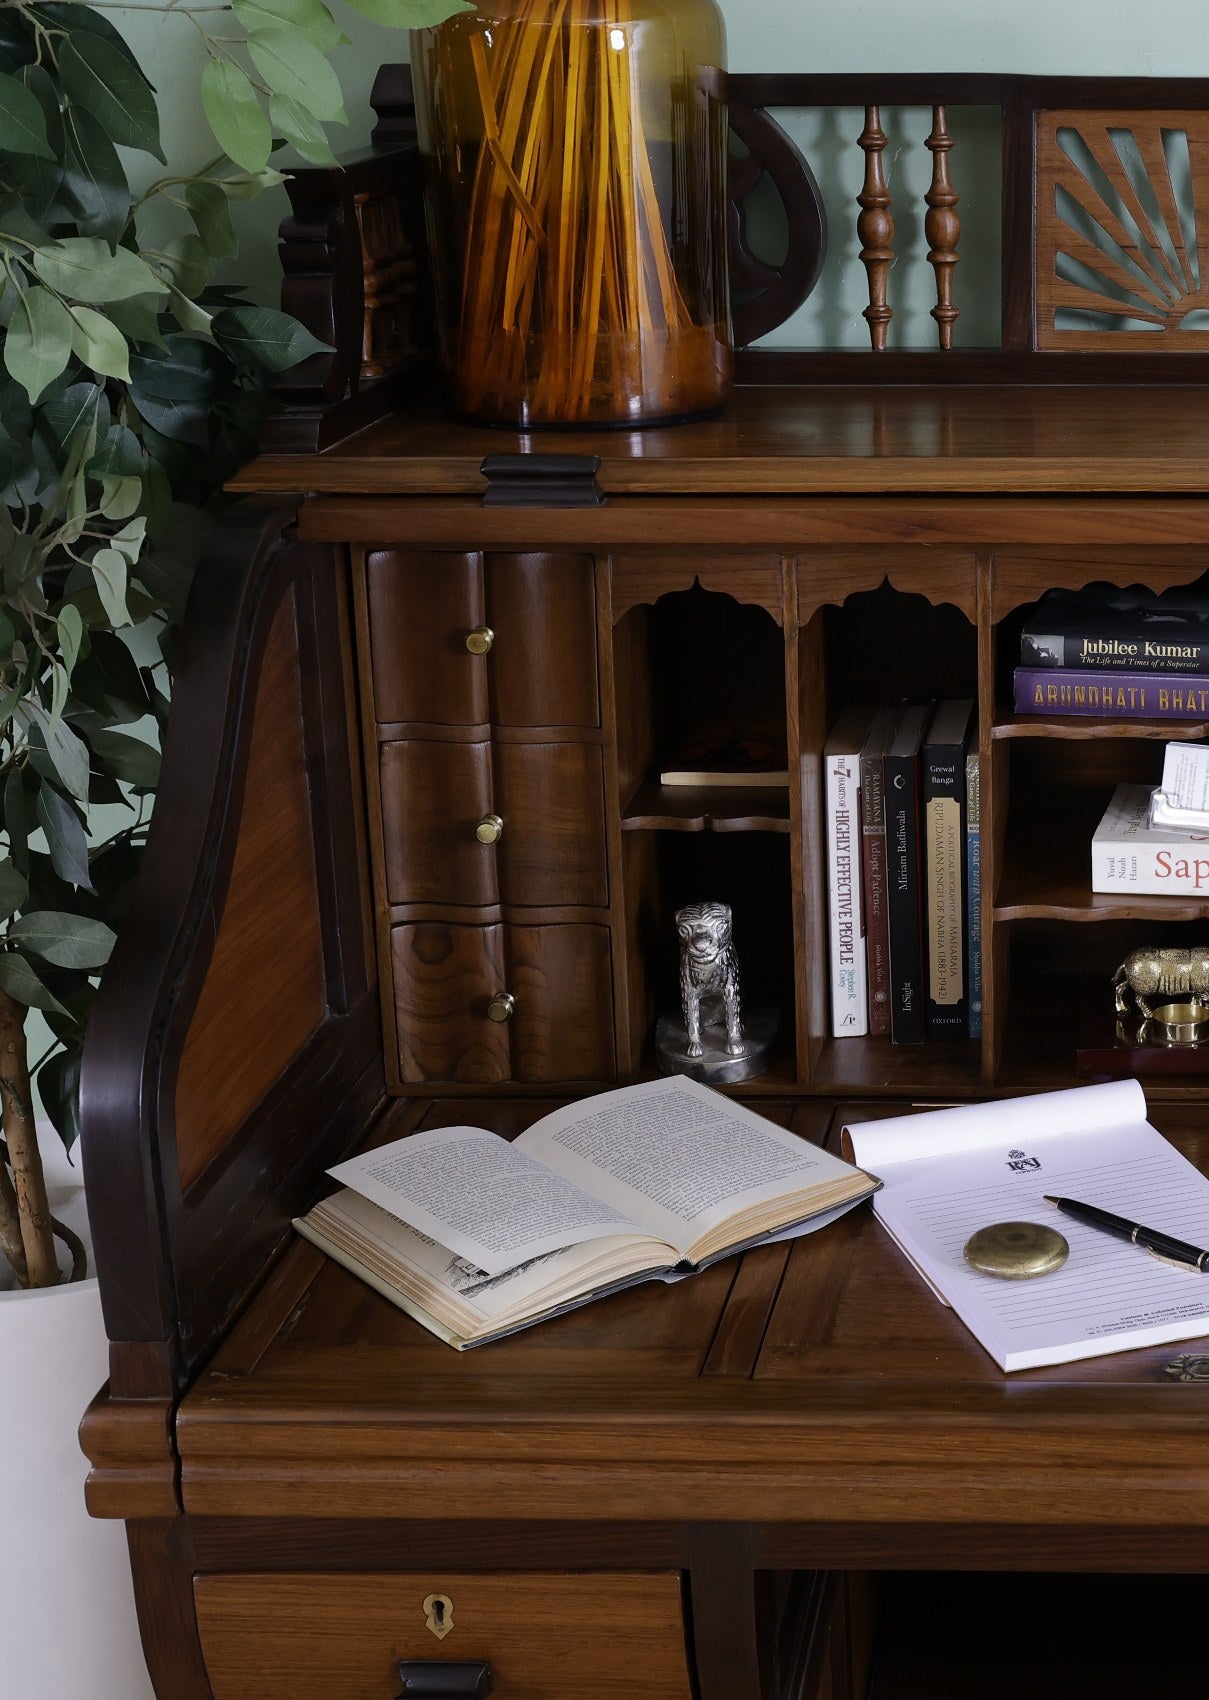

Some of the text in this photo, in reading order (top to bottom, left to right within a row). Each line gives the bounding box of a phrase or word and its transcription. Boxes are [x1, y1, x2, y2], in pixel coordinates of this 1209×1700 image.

[1080, 639, 1201, 658] Jubilee Kumar
[1081, 656, 1094, 664] The
[1096, 657, 1111, 666] Life
[1151, 659, 1159, 668] of
[1166, 660, 1200, 669] Superstar
[1034, 684, 1145, 709] ARUNDHATI
[833, 769, 851, 778] 7
[929, 765, 955, 773] Grewal
[931, 776, 954, 785] Banga
[838, 777, 846, 800] HABITS
[873, 774, 881, 822] RAMAYANA
[839, 800, 847, 809] OF
[835, 809, 850, 853] HIGHLY
[896, 810, 908, 890] Miriam Batliwala
[871, 840, 882, 916] Adopt Patience
[1107, 857, 1115, 878] Yuval
[1118, 857, 1126, 879] Noah
[1129, 855, 1137, 881] Harari
[837, 855, 852, 919] EFFECTIVE
[948, 871, 957, 913] BIOGRAPHY
[934, 802, 947, 1000] RIPUDAMAN SINGH OF NABHA (1883-1942)
[949, 914, 956, 924] OF
[839, 921, 853, 965] PEOPLE
[949, 926, 958, 977] MAHARAJA
[838, 969, 846, 987] Covey
[847, 969, 855, 993] Stephen
[902, 982, 913, 1011] InSight
